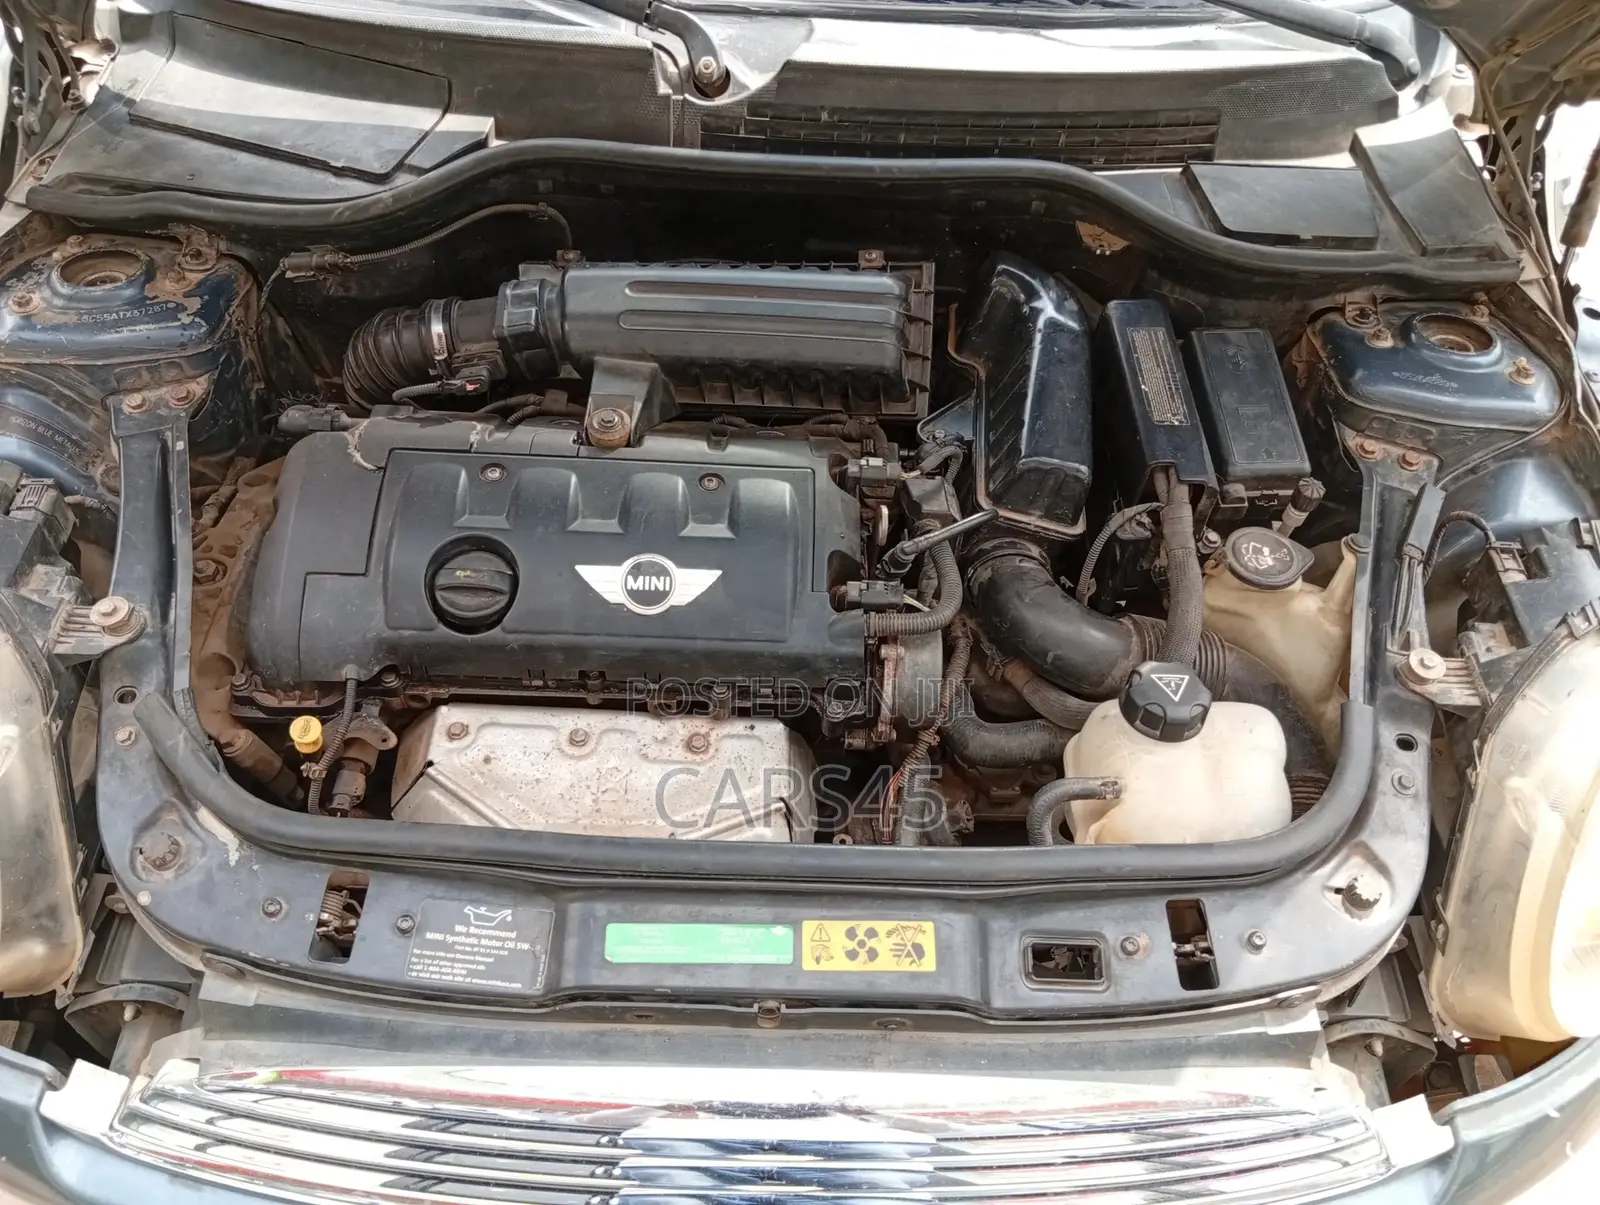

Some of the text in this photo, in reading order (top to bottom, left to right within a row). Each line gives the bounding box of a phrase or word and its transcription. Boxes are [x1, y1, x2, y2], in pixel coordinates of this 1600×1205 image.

[9, 415, 37, 430] HORIZON
[37, 425, 54, 438] BLUE
[626, 573, 671, 591] MINI
[425, 931, 445, 940] MINI
[445, 934, 480, 944] Synthetic
[480, 938, 503, 947] Motor
[504, 941, 515, 949] Oil
[455, 924, 517, 938] We Recommend
